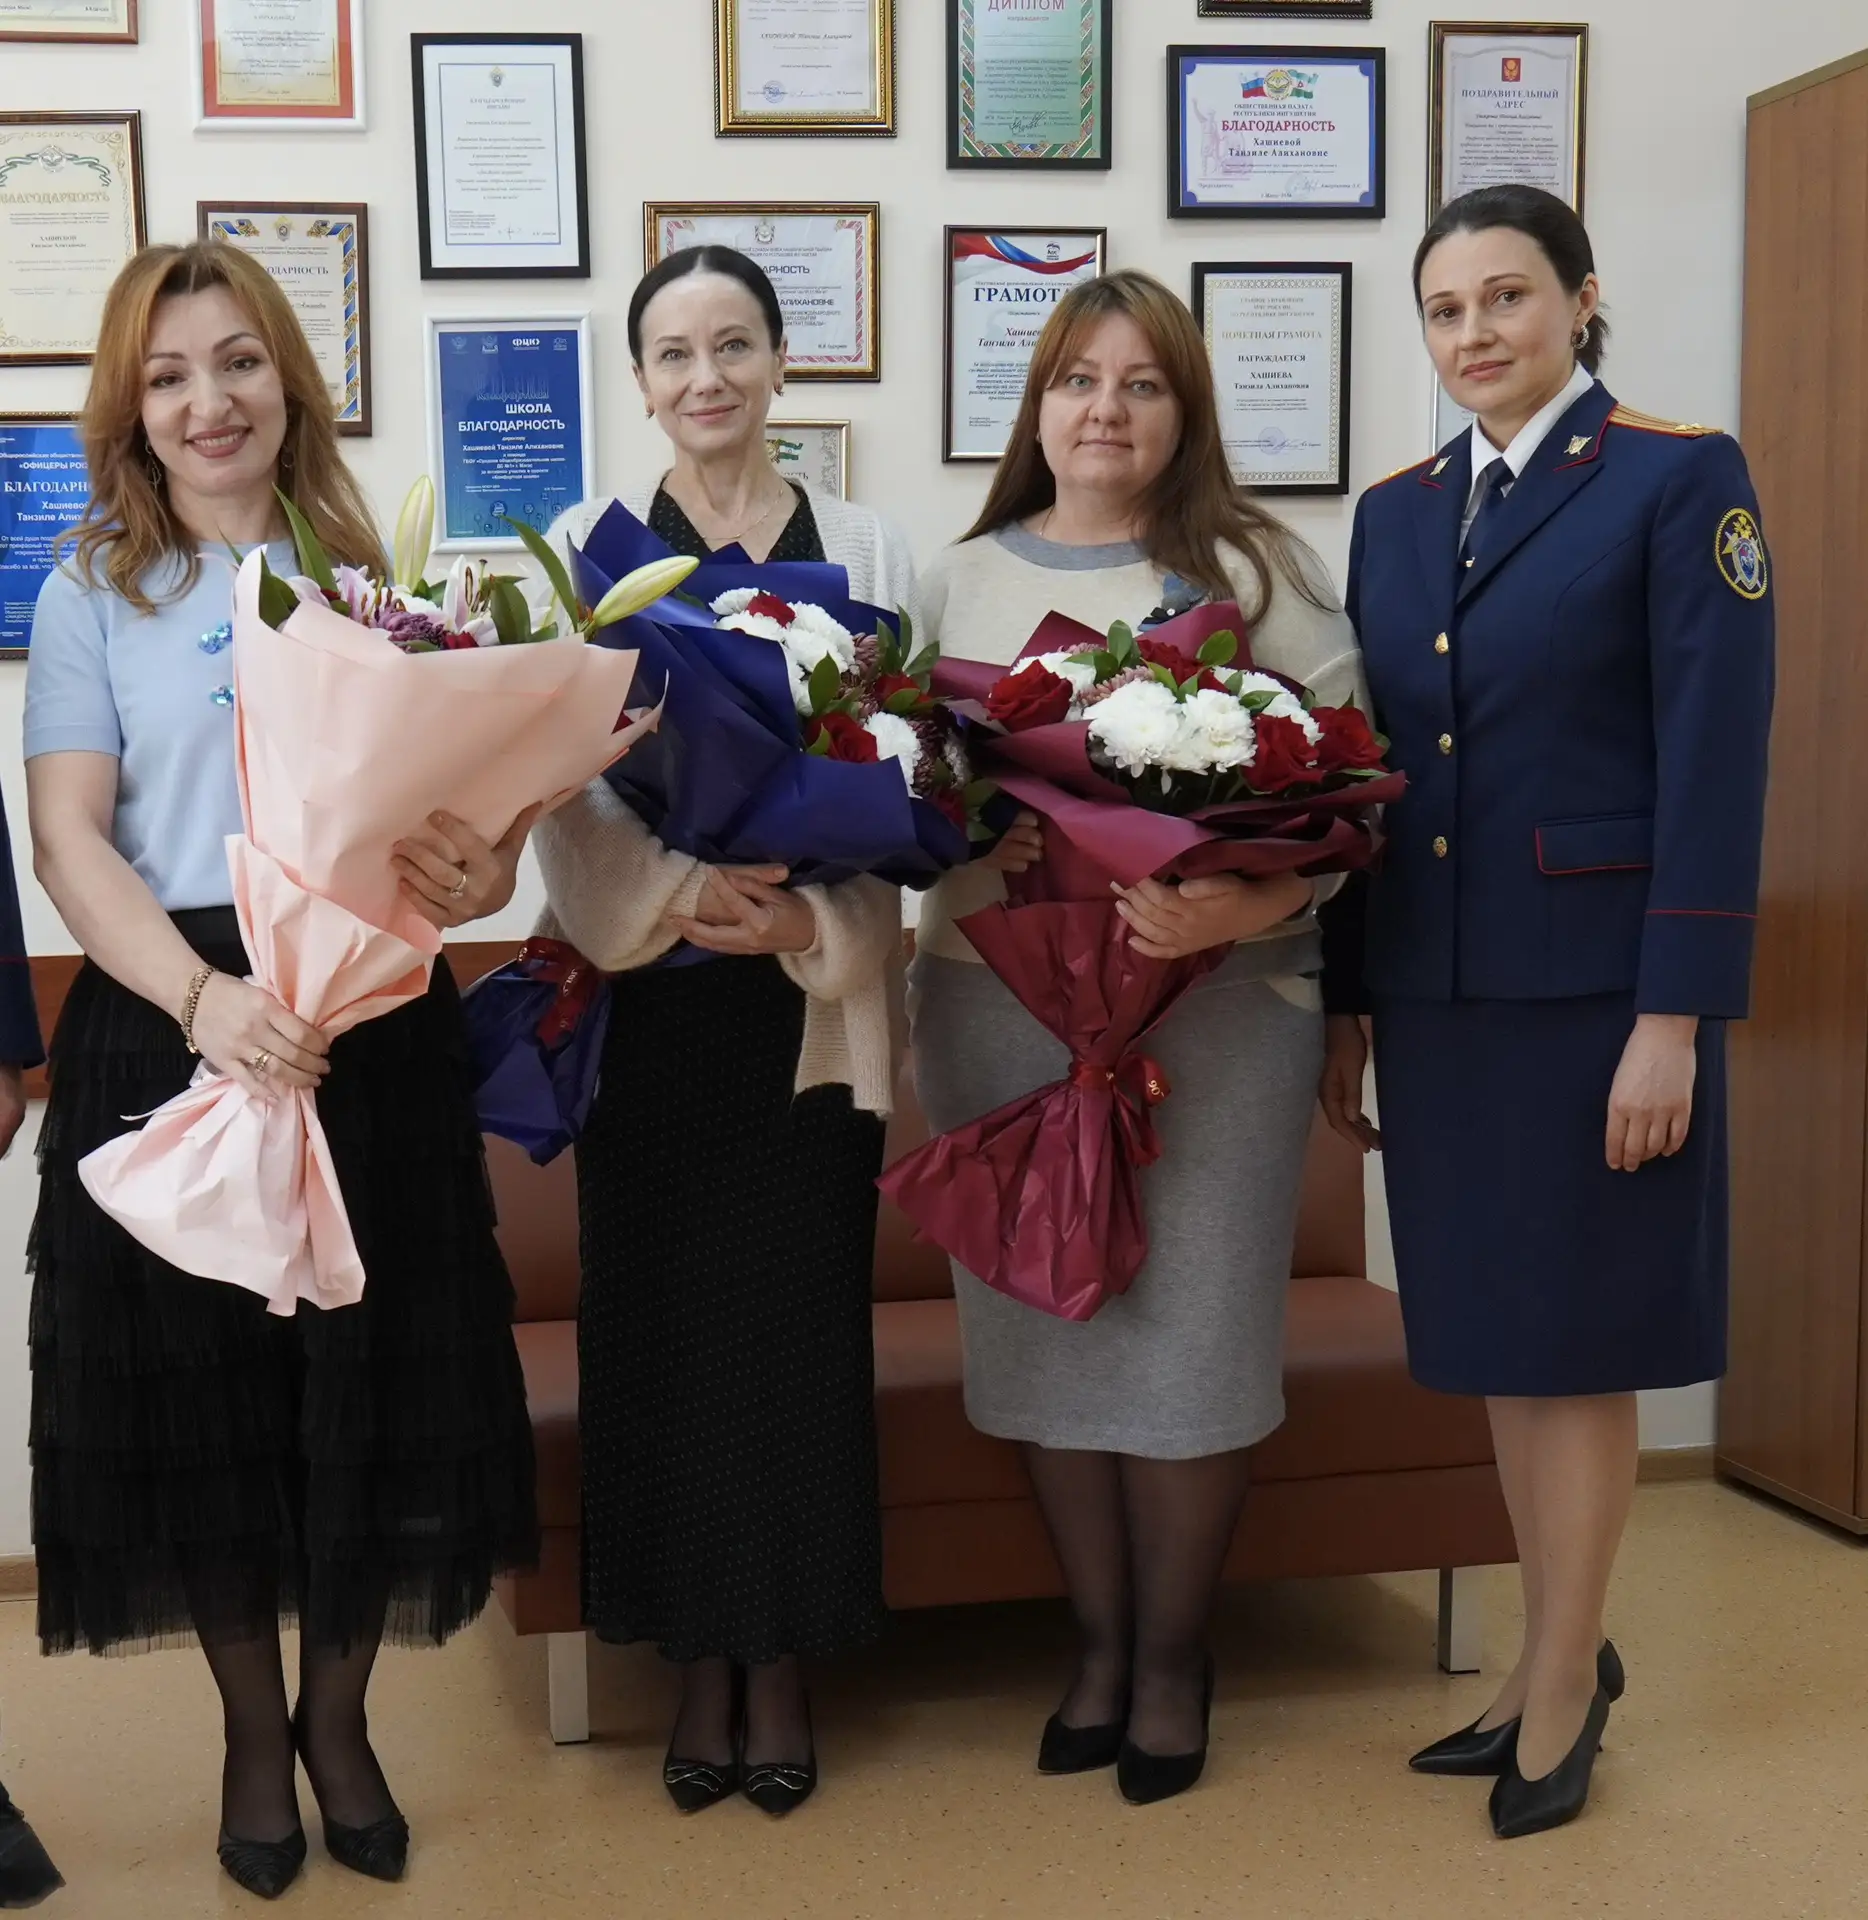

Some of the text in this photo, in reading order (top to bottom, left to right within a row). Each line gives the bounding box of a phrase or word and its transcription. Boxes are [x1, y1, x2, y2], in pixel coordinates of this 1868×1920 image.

[988, 0, 1065, 12] ДИПЛОМ
[1461, 89, 1559, 98] ПОЗДРАВИТЕЛЬНЫЙ
[1495, 101, 1527, 109] АДРЕС
[1221, 120, 1336, 133] БЛАГОДАРНОСТЬ
[1253, 137, 1301, 147] Хашиевой
[1229, 148, 1328, 158] Танзиле Алихановне
[267, 266, 329, 275] ОДАРНОСТЬ
[763, 265, 810, 274] АРНОСТЬ
[973, 287, 1066, 303] ГРАМОТ
[1005, 327, 1042, 337] Хашие
[1277, 331, 1322, 340] ГРАМОТА
[1018, 338, 1038, 348] Али
[1237, 354, 1306, 363] НАГРАЖДАЕТСЯ
[1249, 371, 1293, 380] ХАШИЕВА
[506, 403, 553, 414] ШКОЛА
[458, 419, 566, 433] БЛАГОДАРНОСТЬ
[497, 443, 524, 451] Танзиле
[19, 461, 68, 470] «ОФИЦЕРЫ
[4, 481, 89, 494] БЛАГОДАРН
[17, 512, 56, 521] Танзиле
